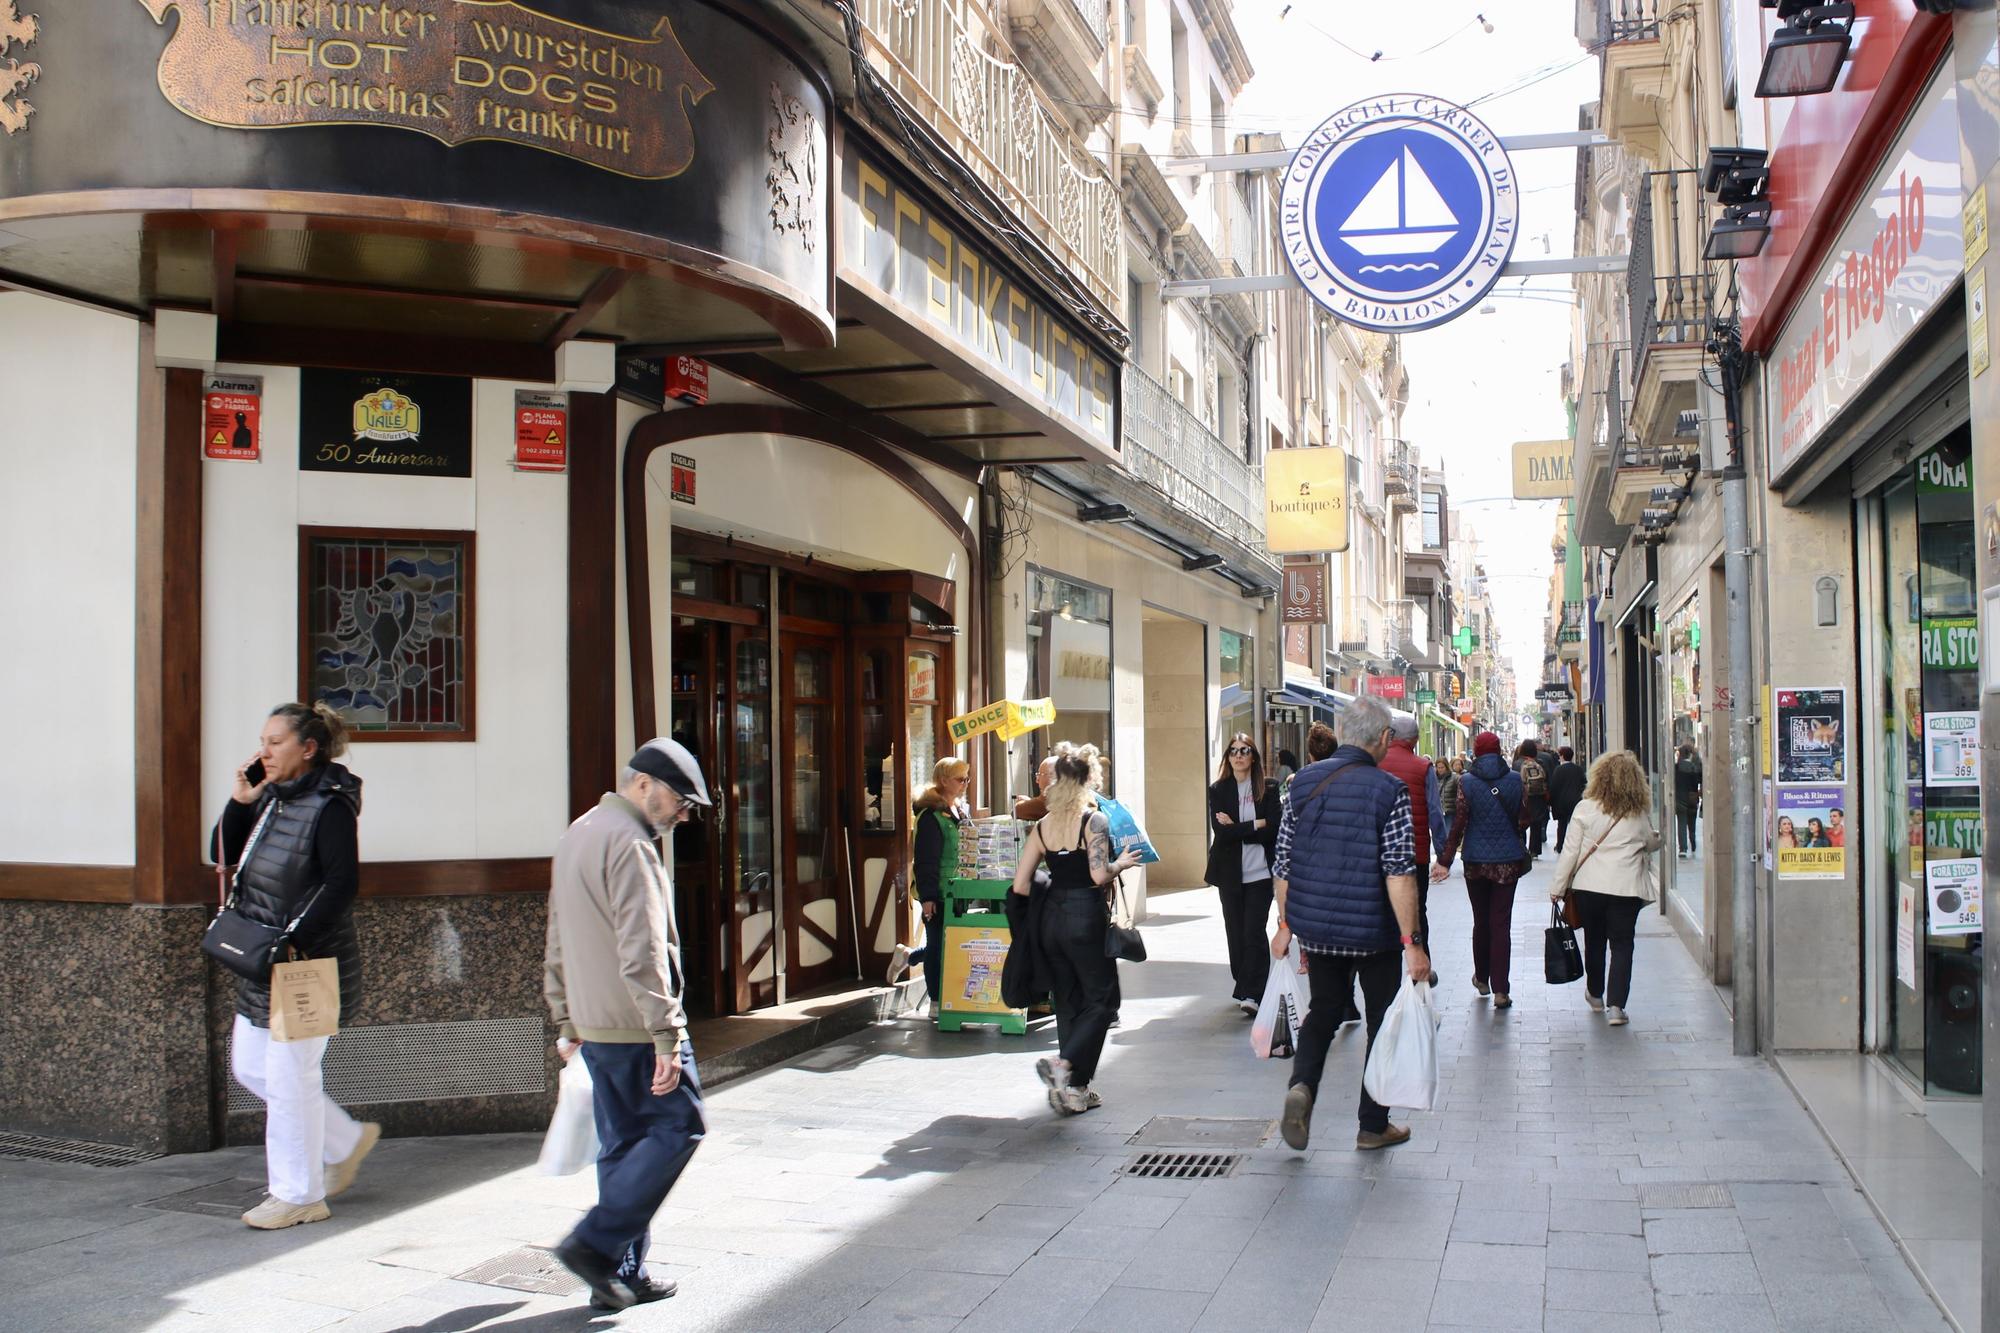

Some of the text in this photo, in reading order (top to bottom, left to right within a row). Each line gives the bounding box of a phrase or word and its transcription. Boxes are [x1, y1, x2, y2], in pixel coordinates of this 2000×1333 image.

[271, 35, 618, 113] HOT DOGS
[477, 98, 632, 153] frankfurt
[1284, 98, 1513, 281] CENTRE COMERCIAL CARRER DE MAR
[1823, 278, 1840, 369] El
[1845, 169, 1925, 342] Regalo
[1344, 292, 1462, 322] BADALONA
[211, 380, 256, 391] Alarma
[316, 443, 449, 467] 50 Aniversari
[671, 454, 695, 469] VIGILAT
[1270, 498, 1330, 515] boutique
[1384, 682, 1403, 691] GAES
[1545, 690, 1569, 698] NOEL
[968, 707, 1004, 729] ONCE
[1930, 717, 1975, 730] FORA STOCK
[1783, 792, 1804, 800] Blues
[1811, 791, 1838, 799] Ritmes
[1824, 852, 1841, 863] LEWIS
[1932, 863, 1977, 878] FORA STOCK
